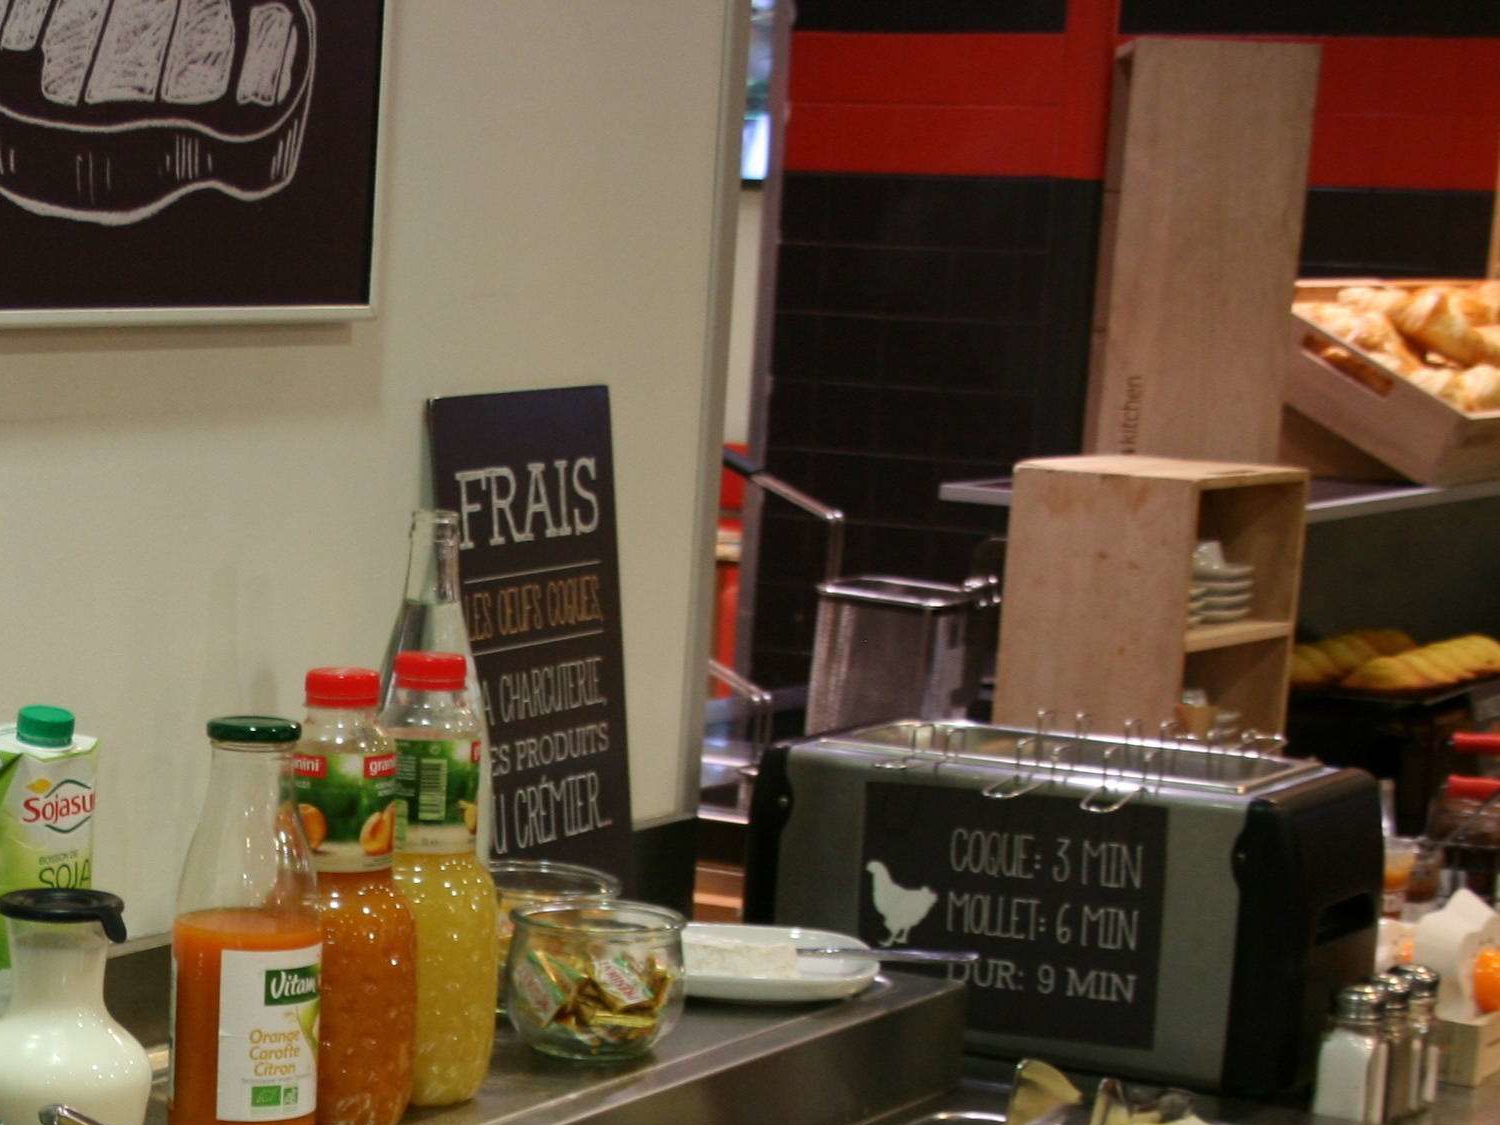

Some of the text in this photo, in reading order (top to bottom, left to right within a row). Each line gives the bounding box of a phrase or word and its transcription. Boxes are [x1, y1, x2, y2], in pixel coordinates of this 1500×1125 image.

[455, 458, 600, 550] FRAIS
[480, 680, 496, 726] A
[491, 745, 511, 777] ES
[515, 722, 610, 771] PRODUITS
[492, 793, 508, 855] U
[950, 828, 1144, 889] COQUE: 3 MIN
[946, 890, 1140, 951] MOLLET: 6 MIN
[1037, 964, 1055, 994] 9
[1065, 966, 1139, 1003] MIN
[254, 1061, 296, 1077] Citron
